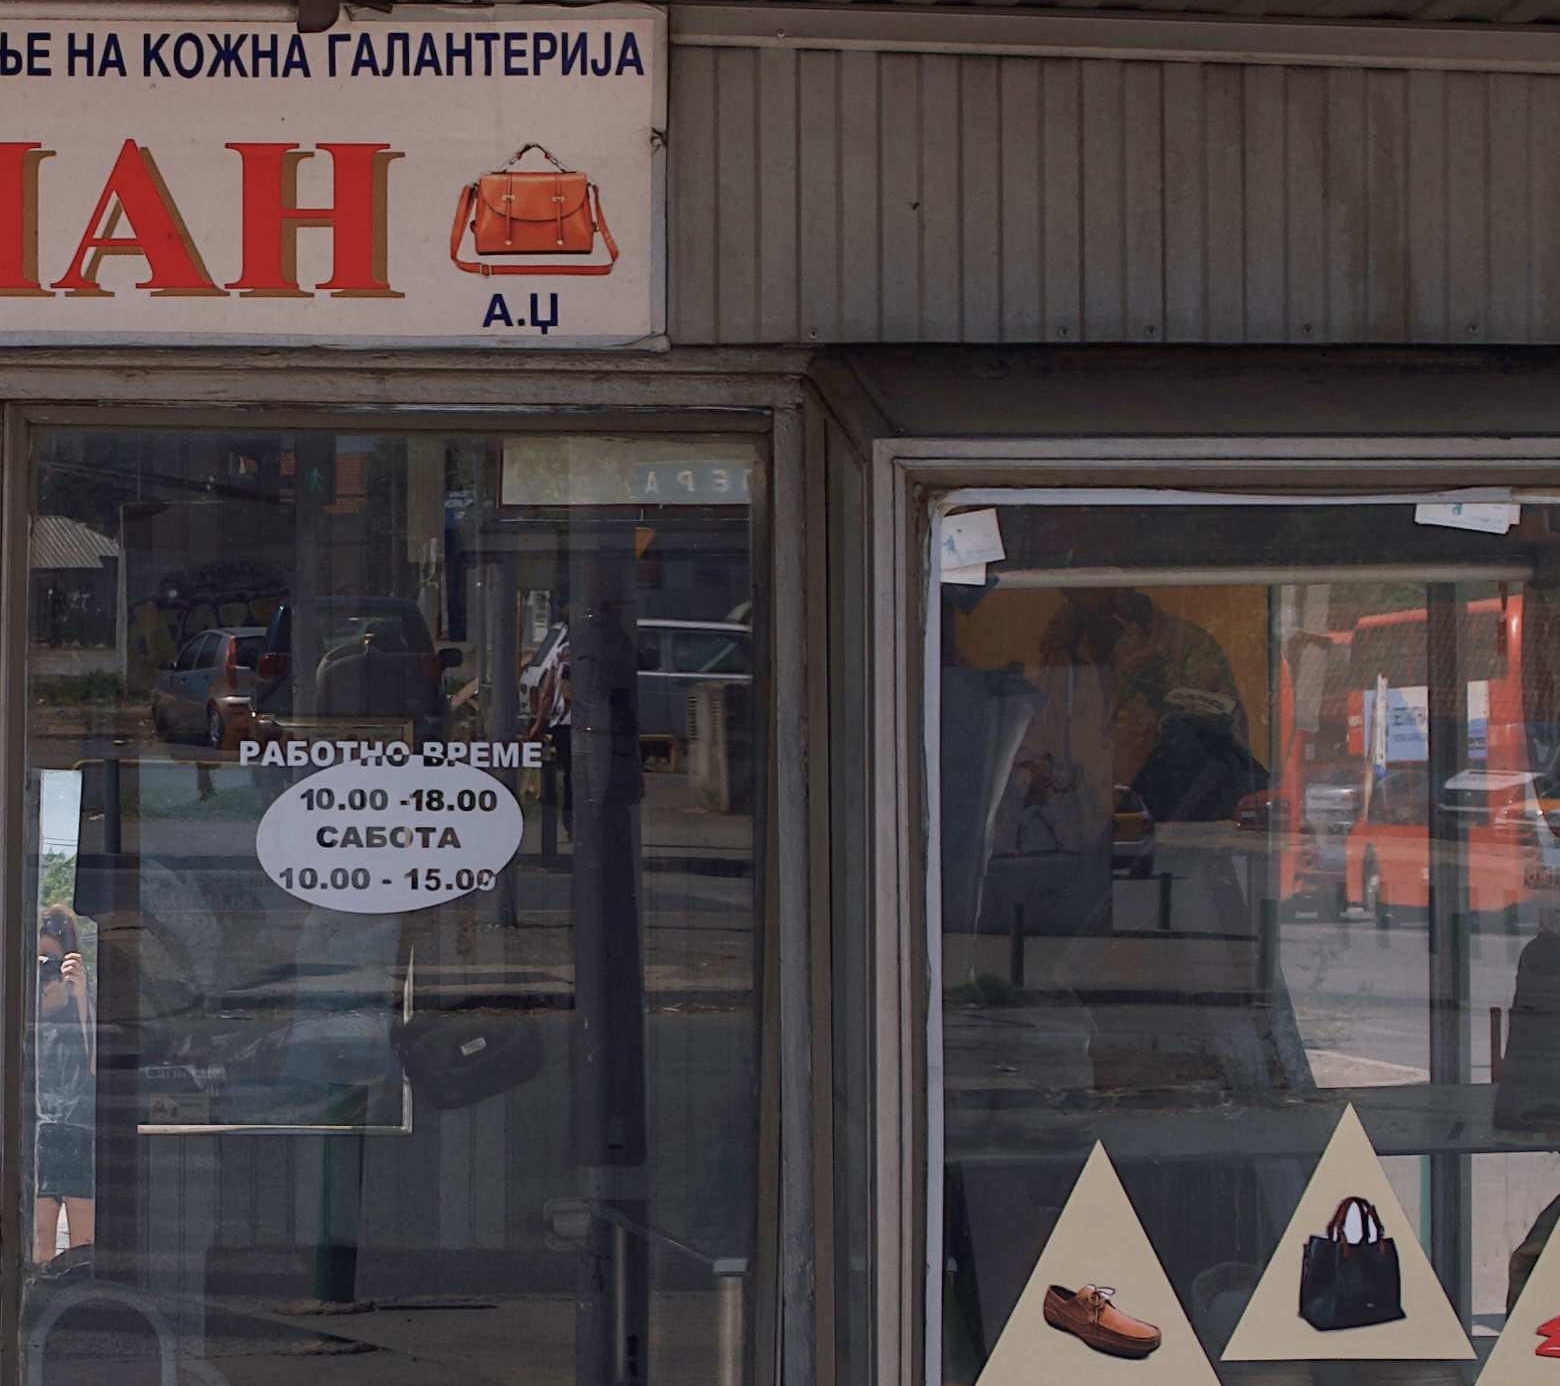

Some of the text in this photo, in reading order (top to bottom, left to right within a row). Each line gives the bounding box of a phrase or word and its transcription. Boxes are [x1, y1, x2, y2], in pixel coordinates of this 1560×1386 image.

[68, 32, 126, 77] НА
[143, 32, 311, 78] КОЖНА
[328, 31, 644, 77] ГАЛАНТЕРИЈА
[240, 740, 544, 768] РАБОТНО ВРЕМЕ
[299, 787, 389, 813] 10.00
[315, 825, 462, 849] САБОТА
[278, 867, 369, 892] 10.00
[404, 867, 497, 892] 15.00
